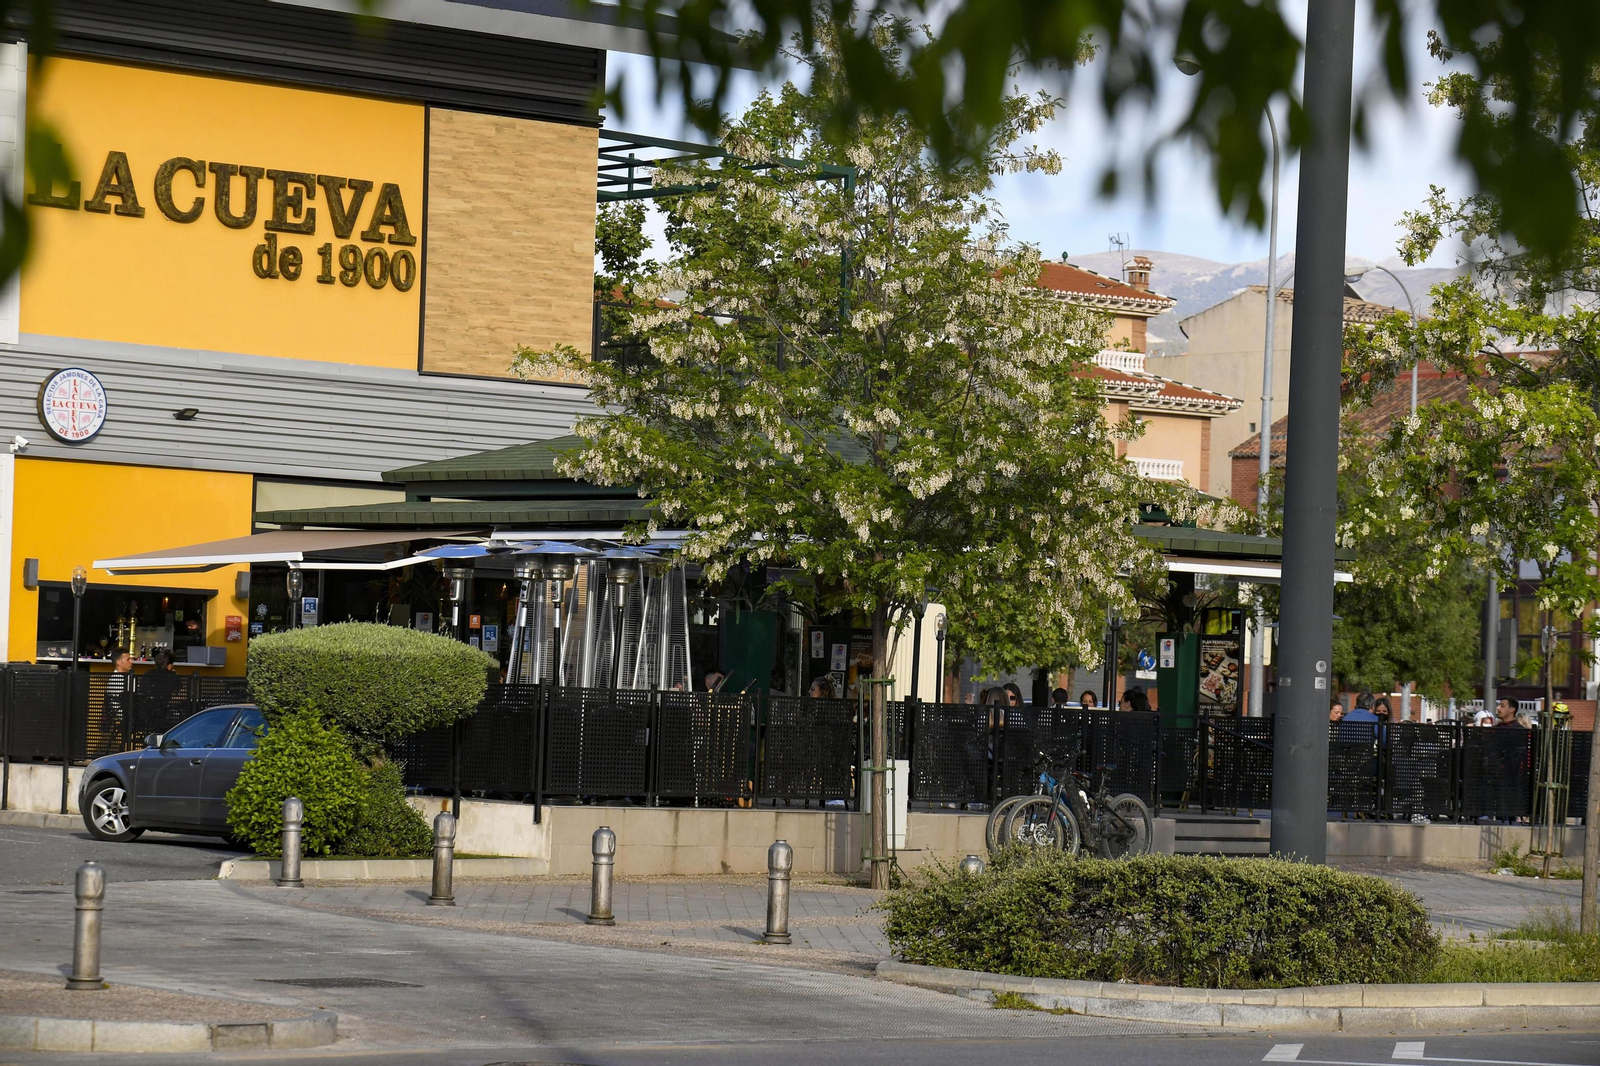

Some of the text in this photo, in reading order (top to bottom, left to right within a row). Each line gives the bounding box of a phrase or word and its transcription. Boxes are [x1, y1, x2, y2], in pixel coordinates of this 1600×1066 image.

[27, 143, 417, 246] LA CUEVA
[252, 233, 417, 292] de 1900
[46, 381, 59, 415] SELECTOS
[59, 371, 88, 382] JAMONES
[88, 378, 97, 388] DE
[95, 388, 102, 397] LA
[52, 400, 98, 410] LA CUEVA
[58, 427, 89, 438] DE 1900
